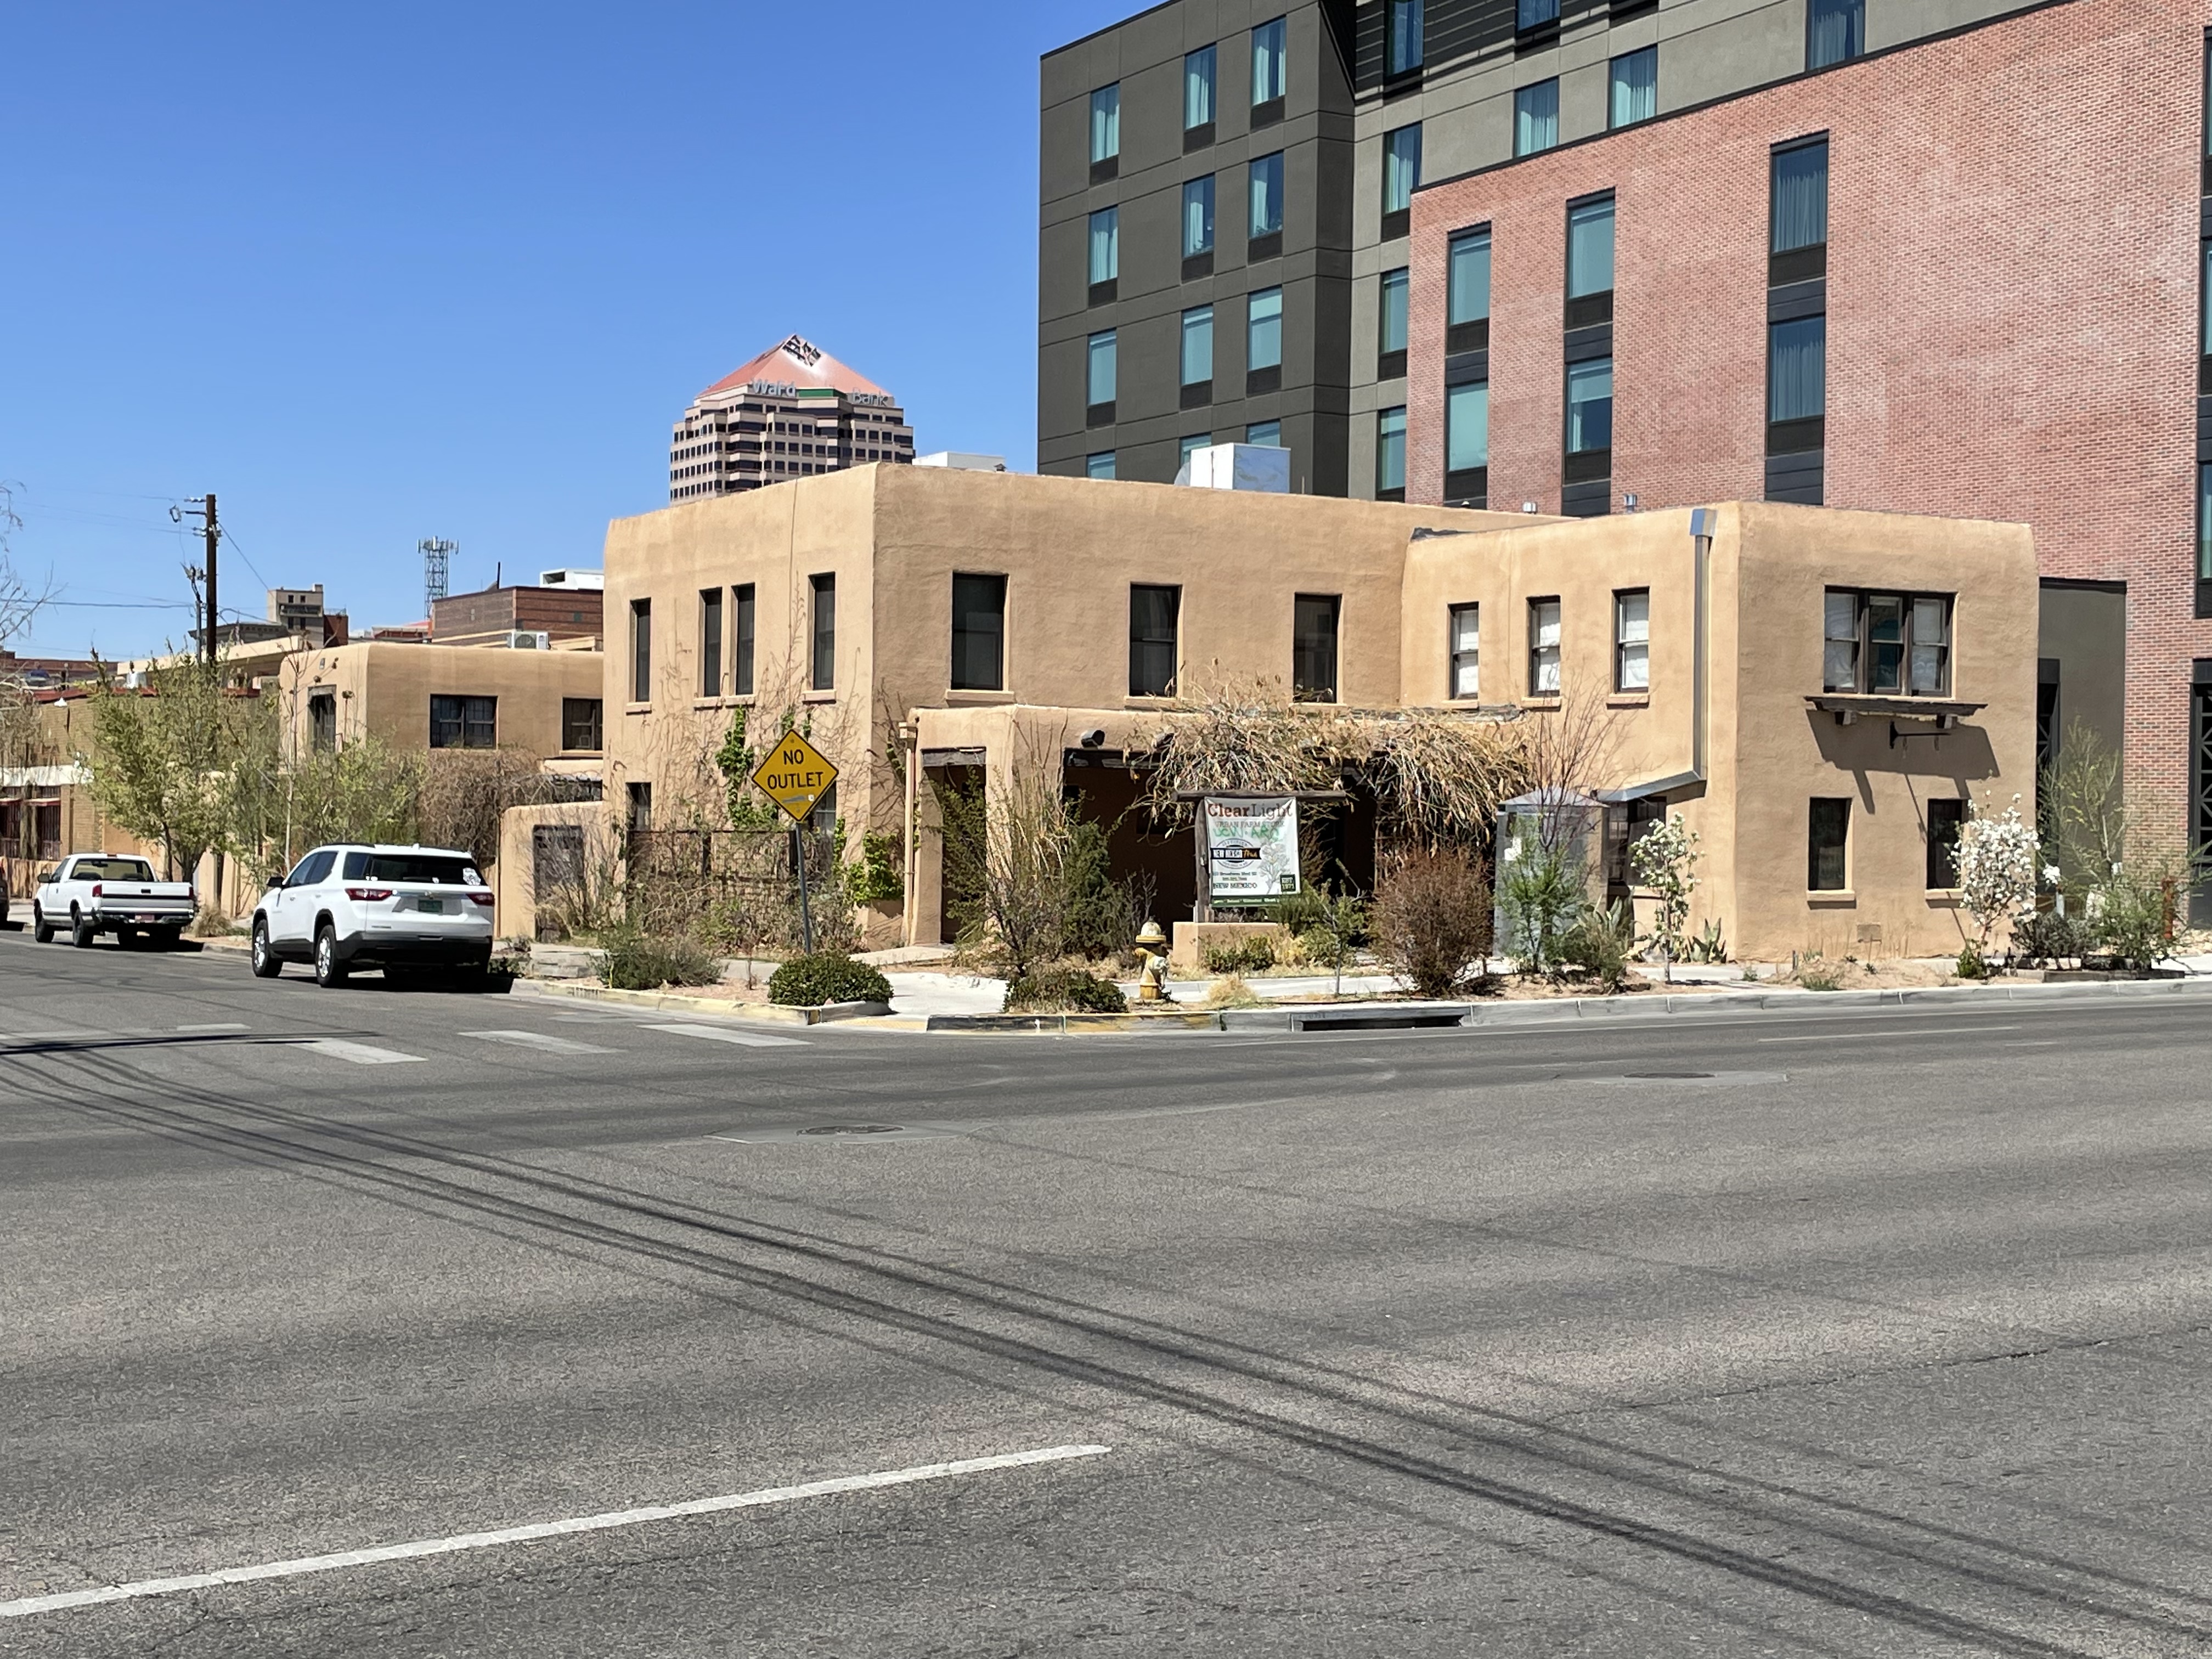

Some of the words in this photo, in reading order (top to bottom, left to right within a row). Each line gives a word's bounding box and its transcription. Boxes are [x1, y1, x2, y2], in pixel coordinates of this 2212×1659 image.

[853, 387, 888, 407] Bank
[783, 749, 804, 765] NO
[768, 772, 823, 789] OUTLET
